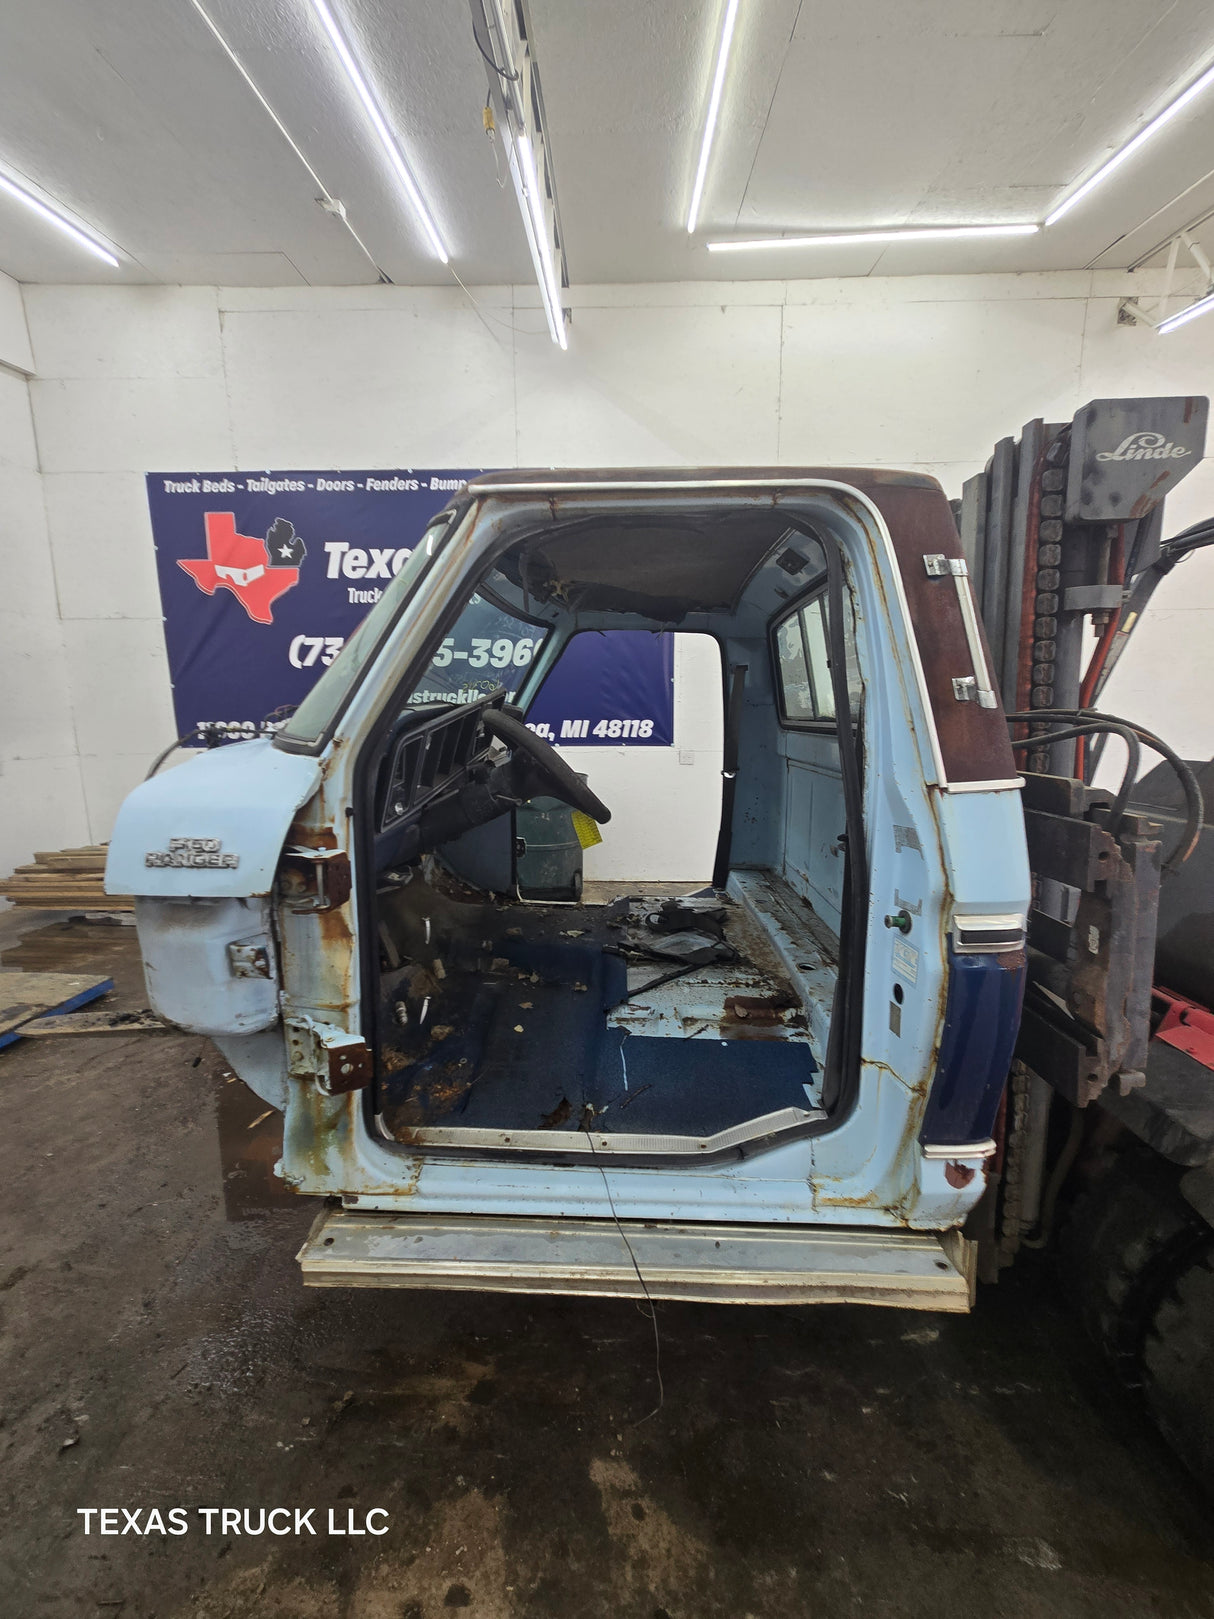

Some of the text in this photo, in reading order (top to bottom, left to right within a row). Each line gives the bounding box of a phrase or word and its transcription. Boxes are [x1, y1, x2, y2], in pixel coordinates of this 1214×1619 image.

[1095, 432, 1192, 461] Linde
[164, 479, 200, 493] Truck
[200, 479, 236, 493] Beds
[246, 478, 305, 495] Tailgates
[316, 478, 355, 491] Doors
[366, 477, 418, 491] Fenders
[560, 720, 590, 738] MI
[592, 719, 654, 738] 48118
[145, 851, 240, 869] RANGER
